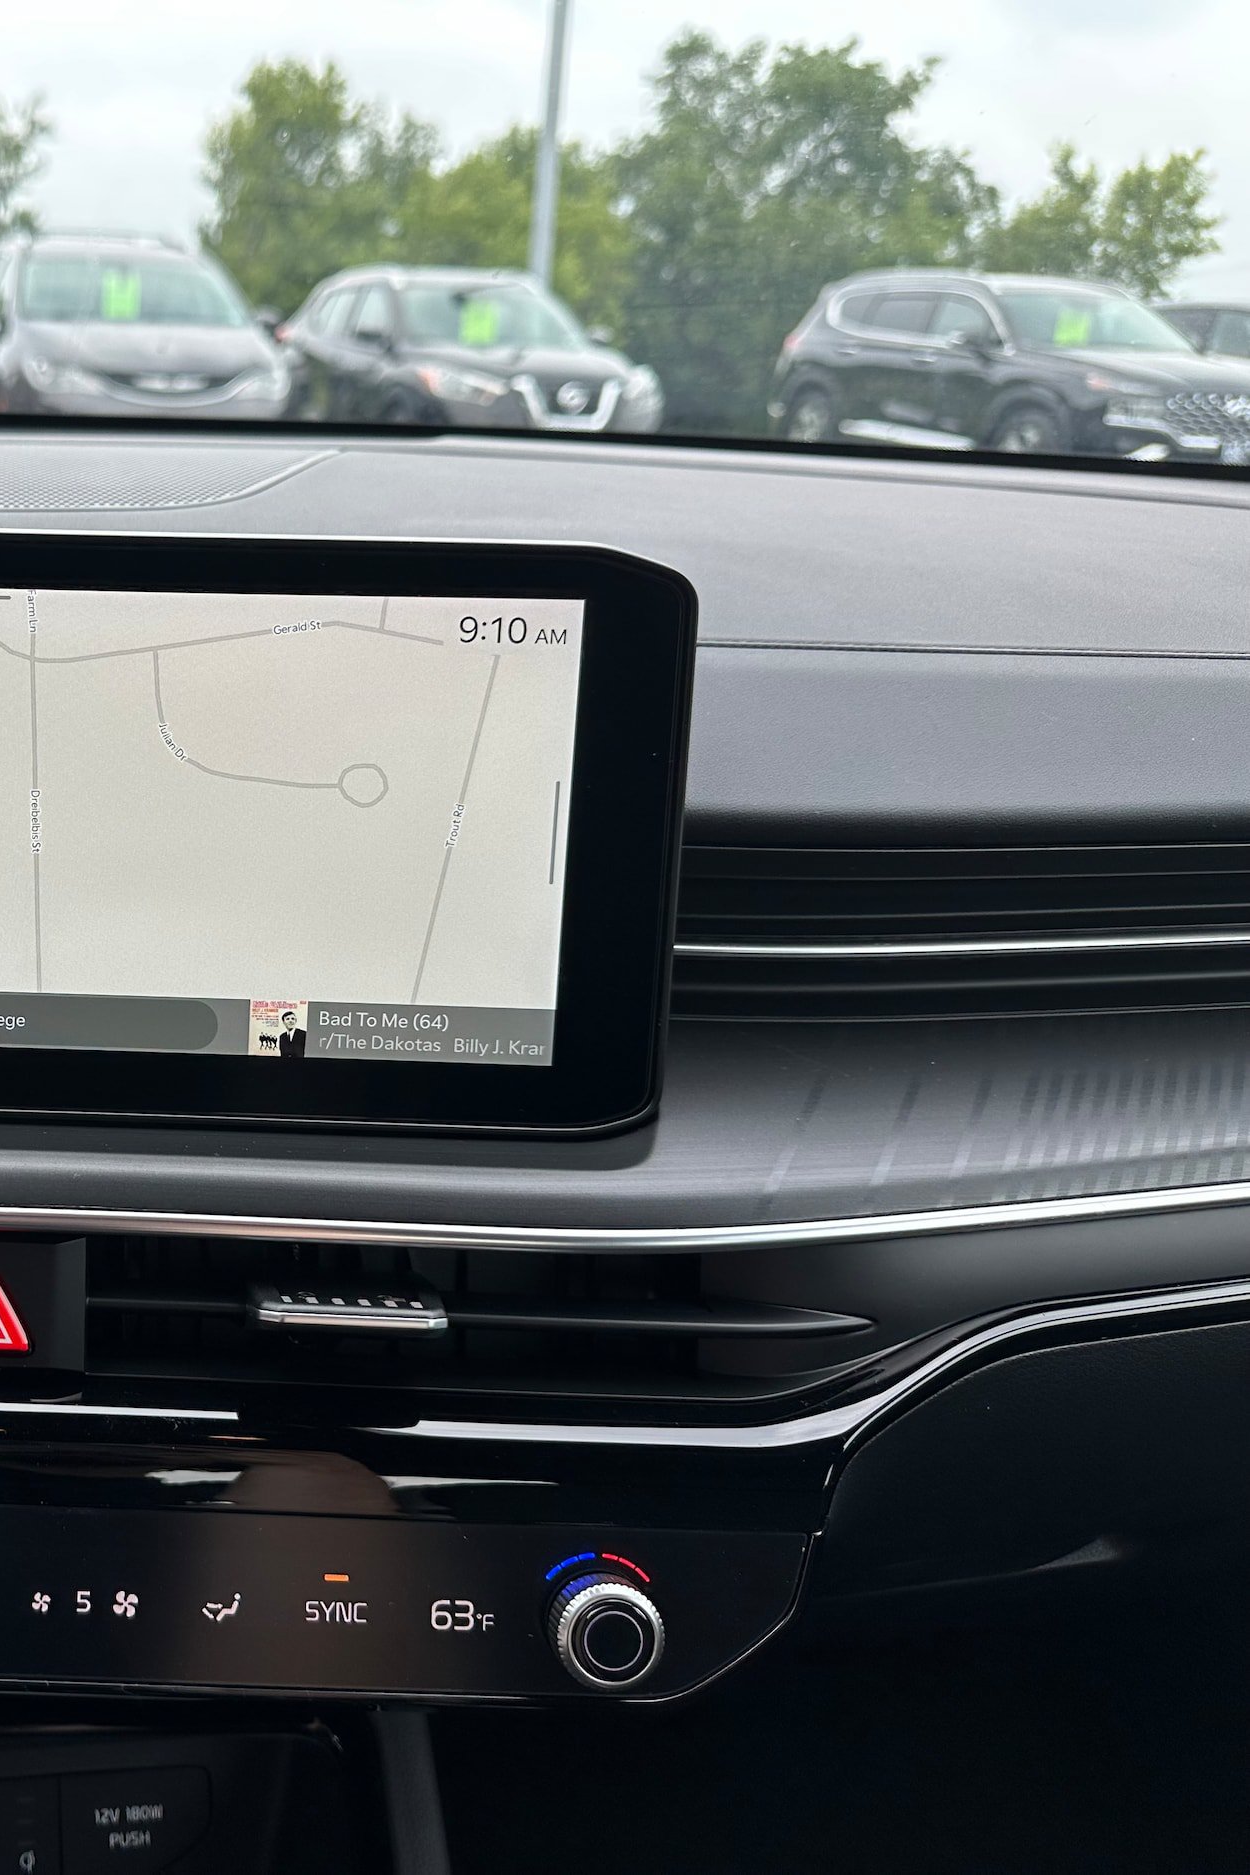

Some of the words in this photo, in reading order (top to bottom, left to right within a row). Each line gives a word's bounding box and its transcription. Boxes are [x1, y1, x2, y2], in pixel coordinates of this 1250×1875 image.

[29, 619, 39, 633] Ln
[273, 621, 307, 635] Gerald
[309, 620, 322, 631] St
[459, 616, 528, 644] 9:10
[535, 628, 568, 645] AM
[158, 723, 177, 751] Julian
[174, 747, 187, 761] Dr
[31, 790, 41, 840] Dreibelbis
[452, 803, 465, 818] Rd
[444, 819, 462, 848] Trout
[31, 842, 42, 853] St
[319, 1010, 352, 1027] Bad
[355, 1012, 378, 1028] To
[381, 1013, 409, 1029] Me
[413, 1012, 450, 1032] (64)
[371, 1035, 442, 1053] Dakotas
[453, 1037, 489, 1058] Billy
[491, 1039, 505, 1055] J.
[76, 1590, 92, 1613] 5
[305, 1600, 368, 1624] SYNC
[94, 1807, 121, 1824] 12V
[108, 1830, 152, 1848] PUSH
